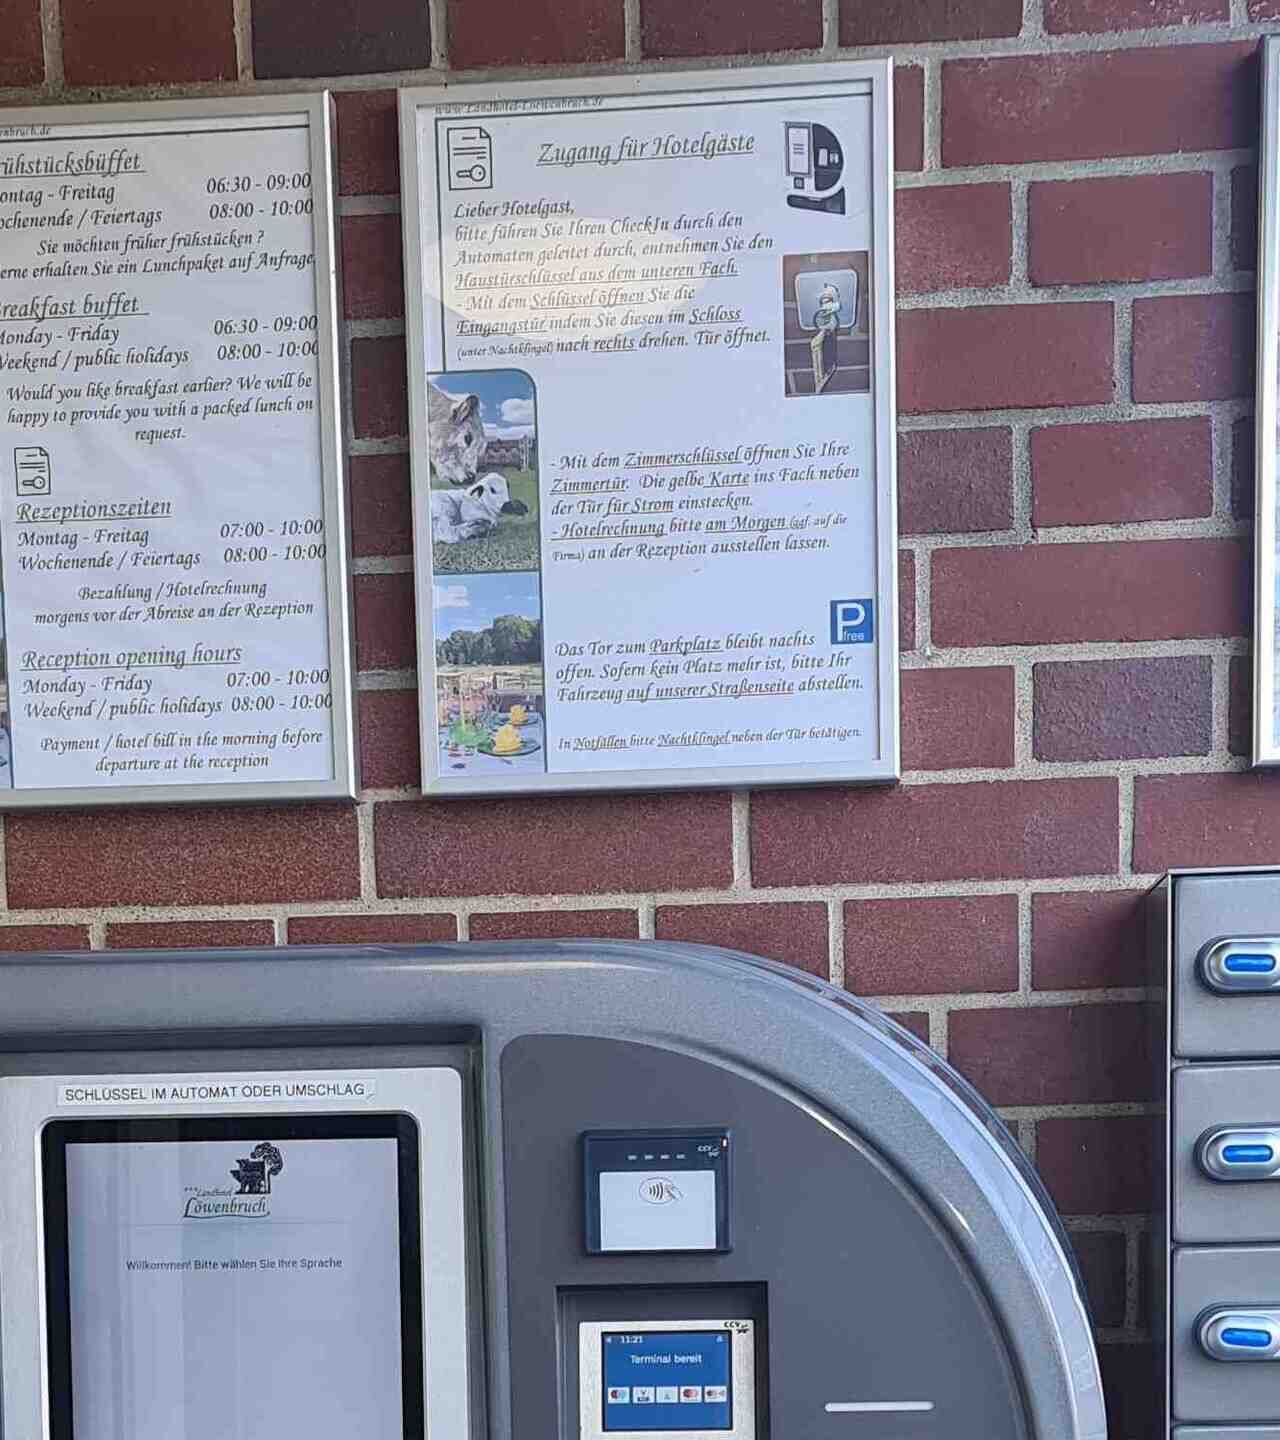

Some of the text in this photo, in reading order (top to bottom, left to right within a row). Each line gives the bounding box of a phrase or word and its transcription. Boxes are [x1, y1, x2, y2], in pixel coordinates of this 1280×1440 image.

[538, 133, 755, 166] Zugang für Hotelgäste
[59, 184, 115, 202] Freitag
[207, 176, 250, 194] 06:30
[267, 173, 311, 190] 09:00
[91, 207, 162, 227] Feiertags
[209, 203, 253, 220] 08:00
[271, 199, 313, 217] 10:00
[455, 198, 574, 218] Lieber Hotelgast,
[37, 231, 252, 256] Sie möchten früher frühstücken
[83, 294, 139, 318] buffet
[68, 325, 120, 345] Friday
[214, 318, 257, 335] 06:30
[274, 316, 318, 333] 09:00
[74, 350, 121, 369] public
[125, 347, 189, 367] holidays
[217, 344, 260, 362] 08:00
[279, 341, 319, 359] 10:00
[558, 442, 850, 470] Mit dem Zimmerschlüssel öffnen Sie Ihre
[18, 499, 171, 523] Rezeptionszeiten
[18, 519, 322, 548] Montag Freitag 07:00 10:00
[20, 543, 326, 570] Wochenende Feiertags 08:00 10:00
[79, 580, 266, 601] Bezahlung Hotelrechnung
[837, 603, 865, 641] P
[555, 632, 815, 657] Das Tor zum Parkplatz bleibt nachts
[844, 631, 864, 641] free
[22, 642, 240, 670] Reception opening hours
[23, 669, 329, 695] Monday Friday 07:00 10:00
[25, 693, 332, 719] Weekend public holidays 08:00 10:00
[151, 1087, 166, 1098] IM
[171, 1085, 236, 1098] AUTOMAT
[242, 1085, 281, 1097] ODER
[285, 1083, 365, 1096] UMSCHLAG
[184, 1197, 270, 1218] Löwenbruch
[126, 1256, 342, 1272] Willkommen! Bitte wählen Sie Ihre Sprache
[630, 1354, 702, 1364] Terminal bereit
